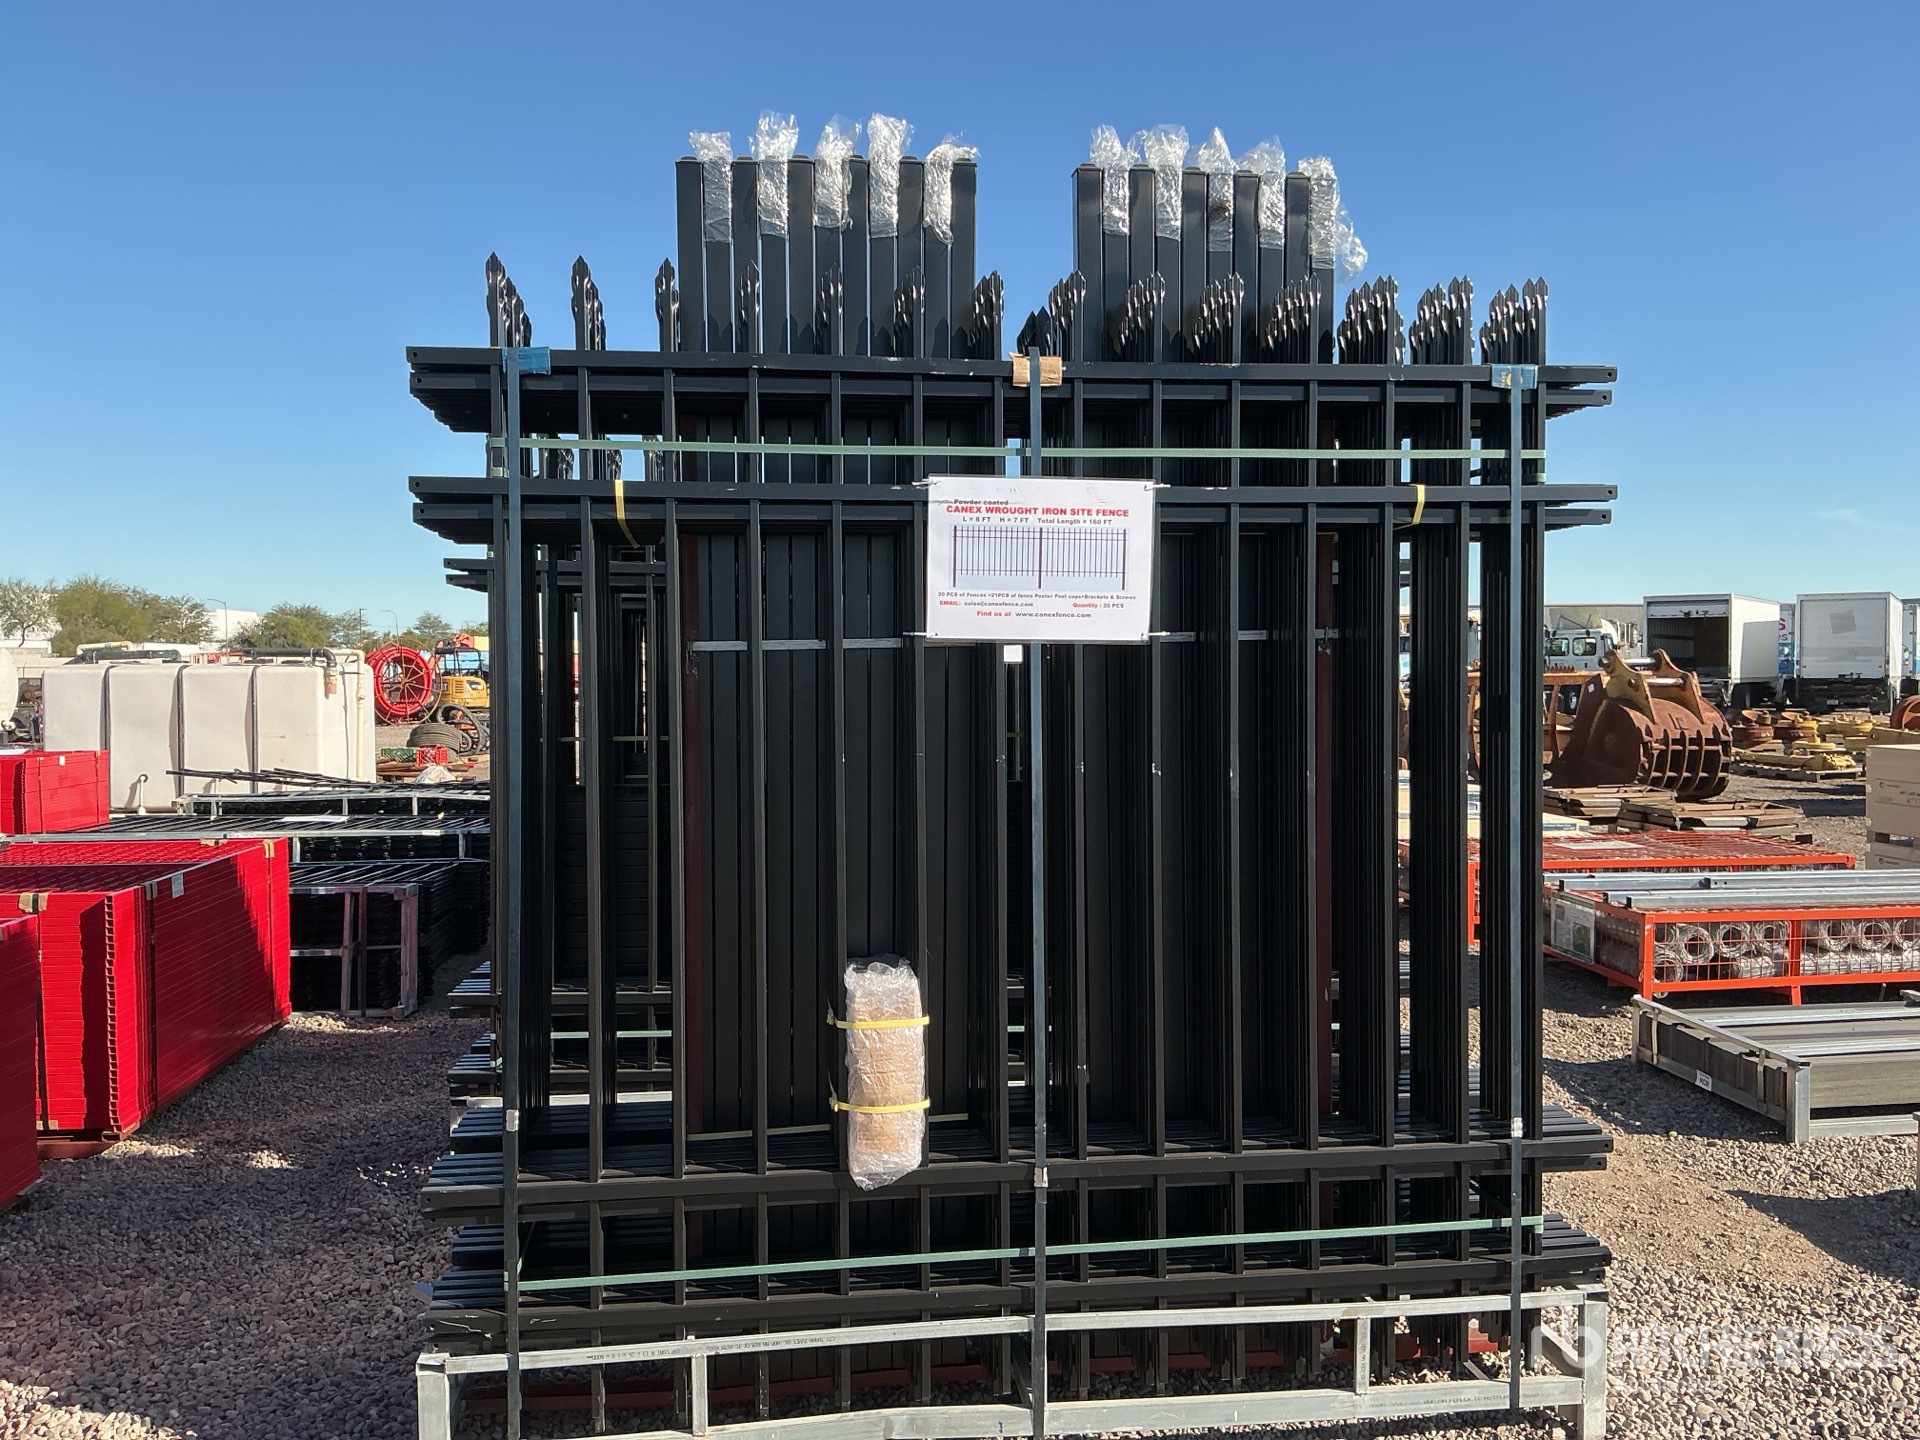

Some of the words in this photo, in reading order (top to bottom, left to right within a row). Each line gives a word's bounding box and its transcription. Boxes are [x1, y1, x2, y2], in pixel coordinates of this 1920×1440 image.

[946, 505, 982, 514] CANEX
[985, 506, 1039, 515] WROUGHT
[1041, 507, 1067, 516] IRON
[1070, 508, 1093, 516] SITE
[1095, 509, 1130, 517] FENCE
[1056, 518, 1081, 526] Length
